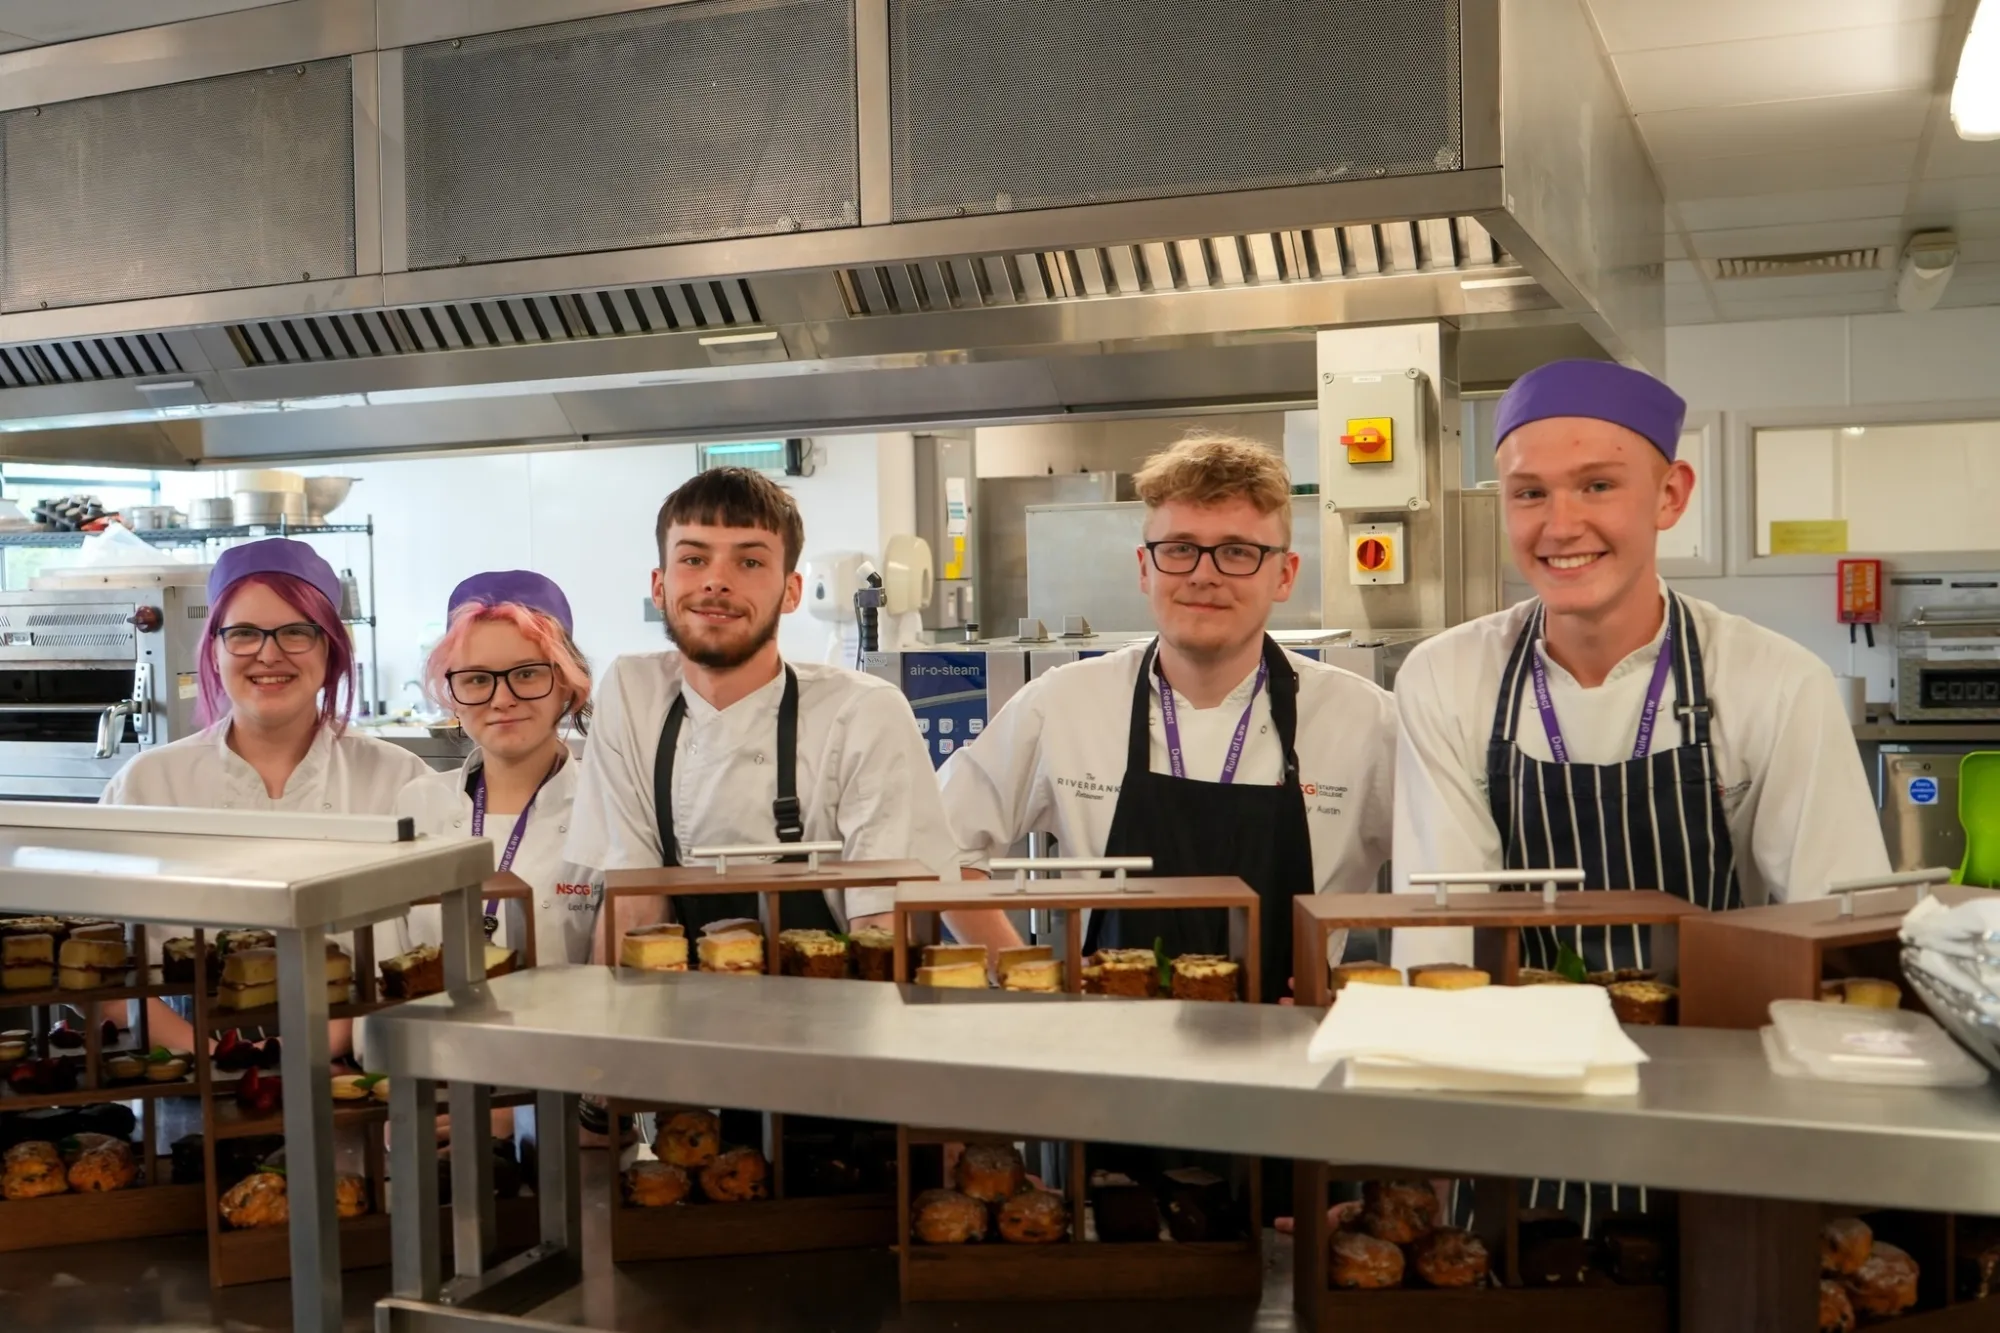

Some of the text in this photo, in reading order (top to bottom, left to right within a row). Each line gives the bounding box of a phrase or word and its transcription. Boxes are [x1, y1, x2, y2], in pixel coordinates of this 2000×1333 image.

[910, 664, 980, 676] air-o-steam
[1536, 669, 1551, 710] Respect
[1163, 688, 1175, 725] Respect
[1635, 700, 1656, 758] Rule of Law
[1225, 724, 1246, 773] Rule of Law
[1057, 777, 1121, 793] RIVERBANK
[1319, 790, 1343, 798] COLLEGE
[1317, 805, 1341, 815] Austin
[509, 834, 520, 851] Law
[556, 883, 591, 896] NSCG
